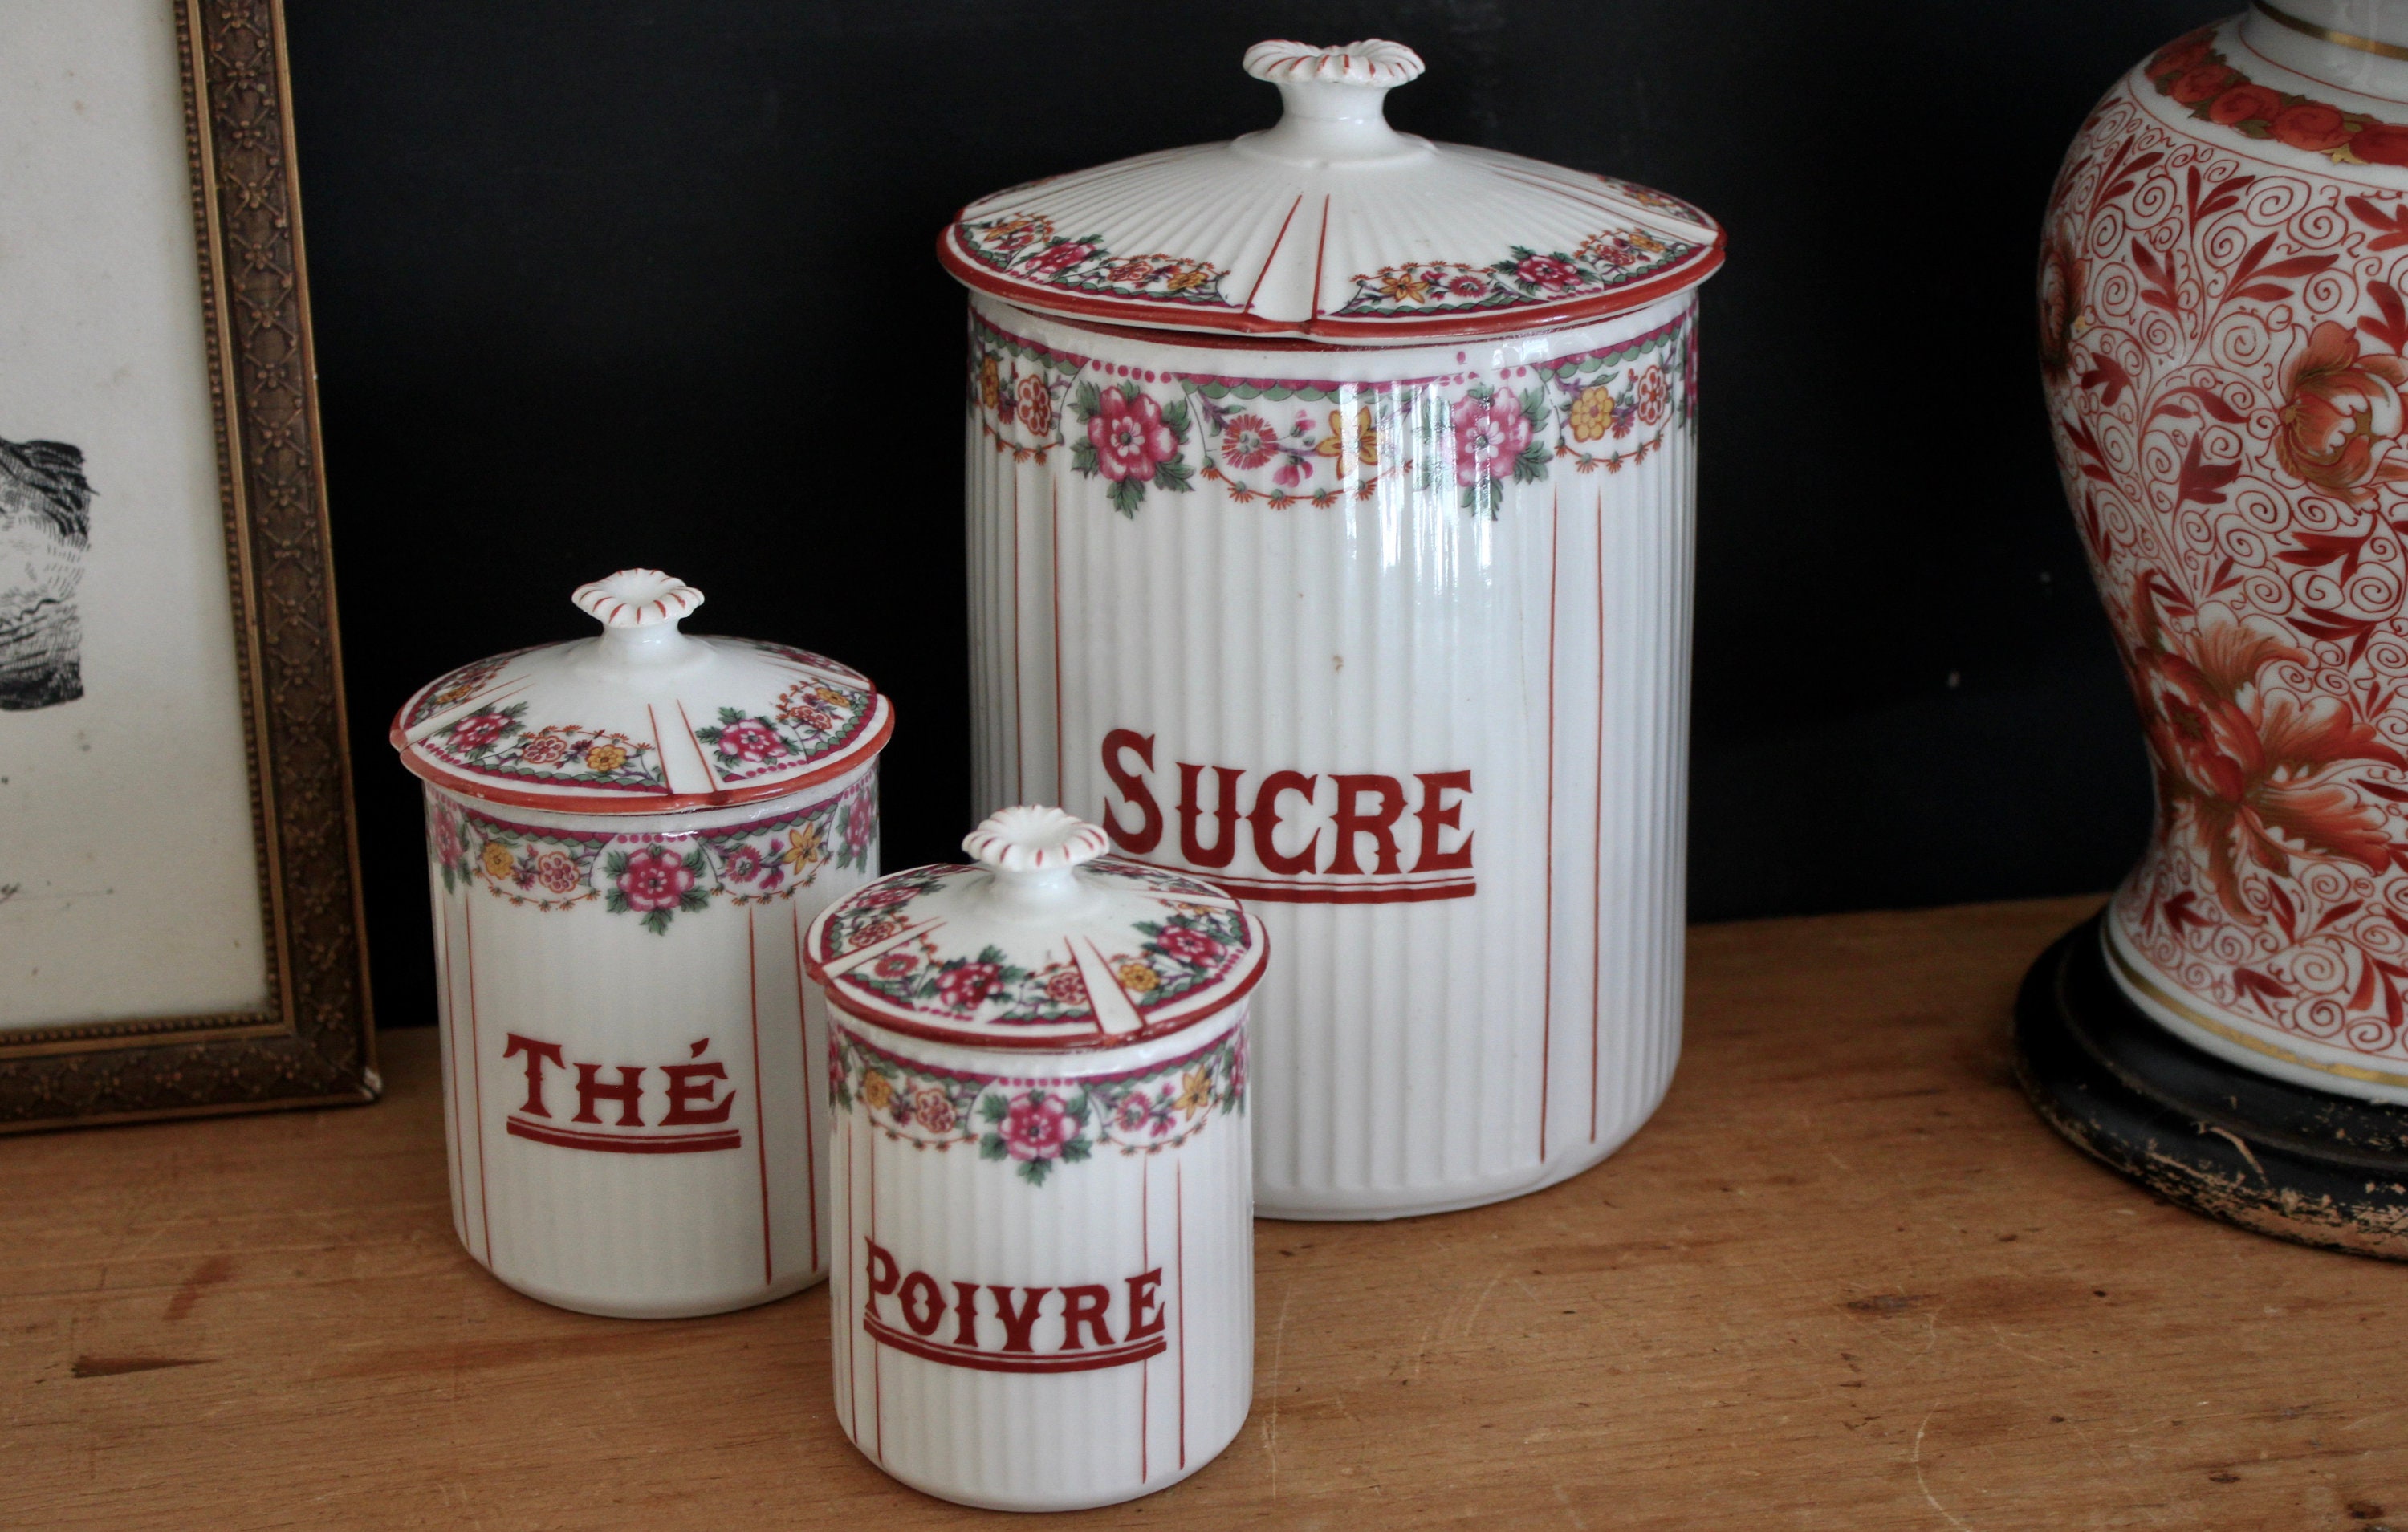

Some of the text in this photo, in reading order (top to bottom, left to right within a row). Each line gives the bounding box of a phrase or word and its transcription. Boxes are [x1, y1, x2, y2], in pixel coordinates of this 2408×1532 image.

[1101, 729, 1475, 876] SUCRE
[502, 1032, 737, 1127] THÉ
[864, 1236, 1165, 1353] POIVRE
